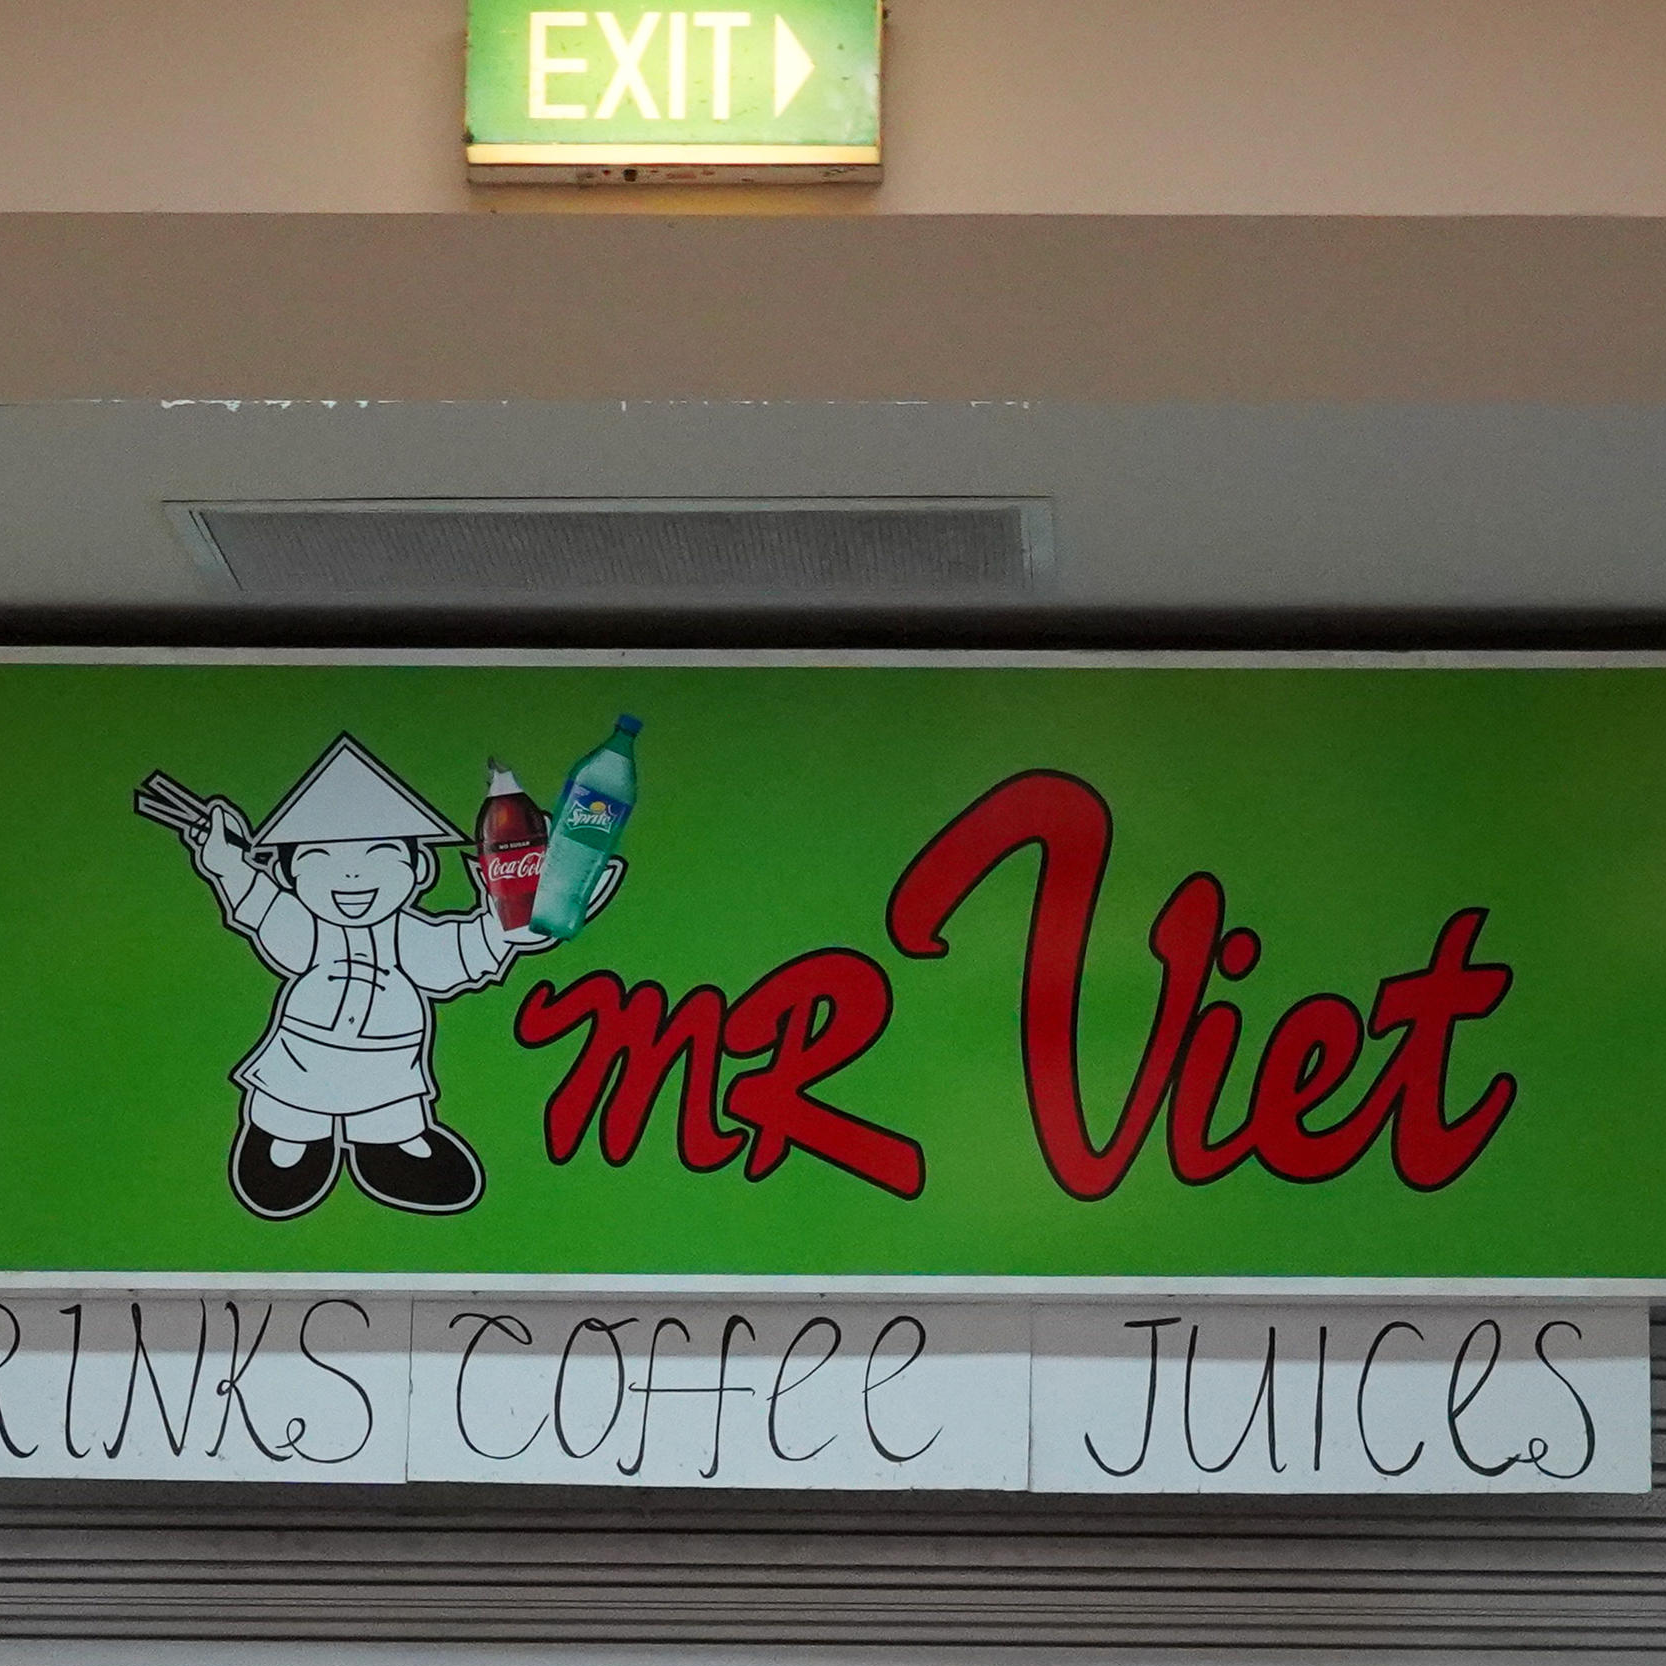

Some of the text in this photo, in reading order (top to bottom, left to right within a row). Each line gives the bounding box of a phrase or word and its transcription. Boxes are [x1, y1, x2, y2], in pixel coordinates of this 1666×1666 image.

[528, 11, 751, 120] EXIT
[572, 808, 611, 827] Sprite
[489, 852, 544, 881] Coca-Col
[886, 767, 1517, 1202] Viet
